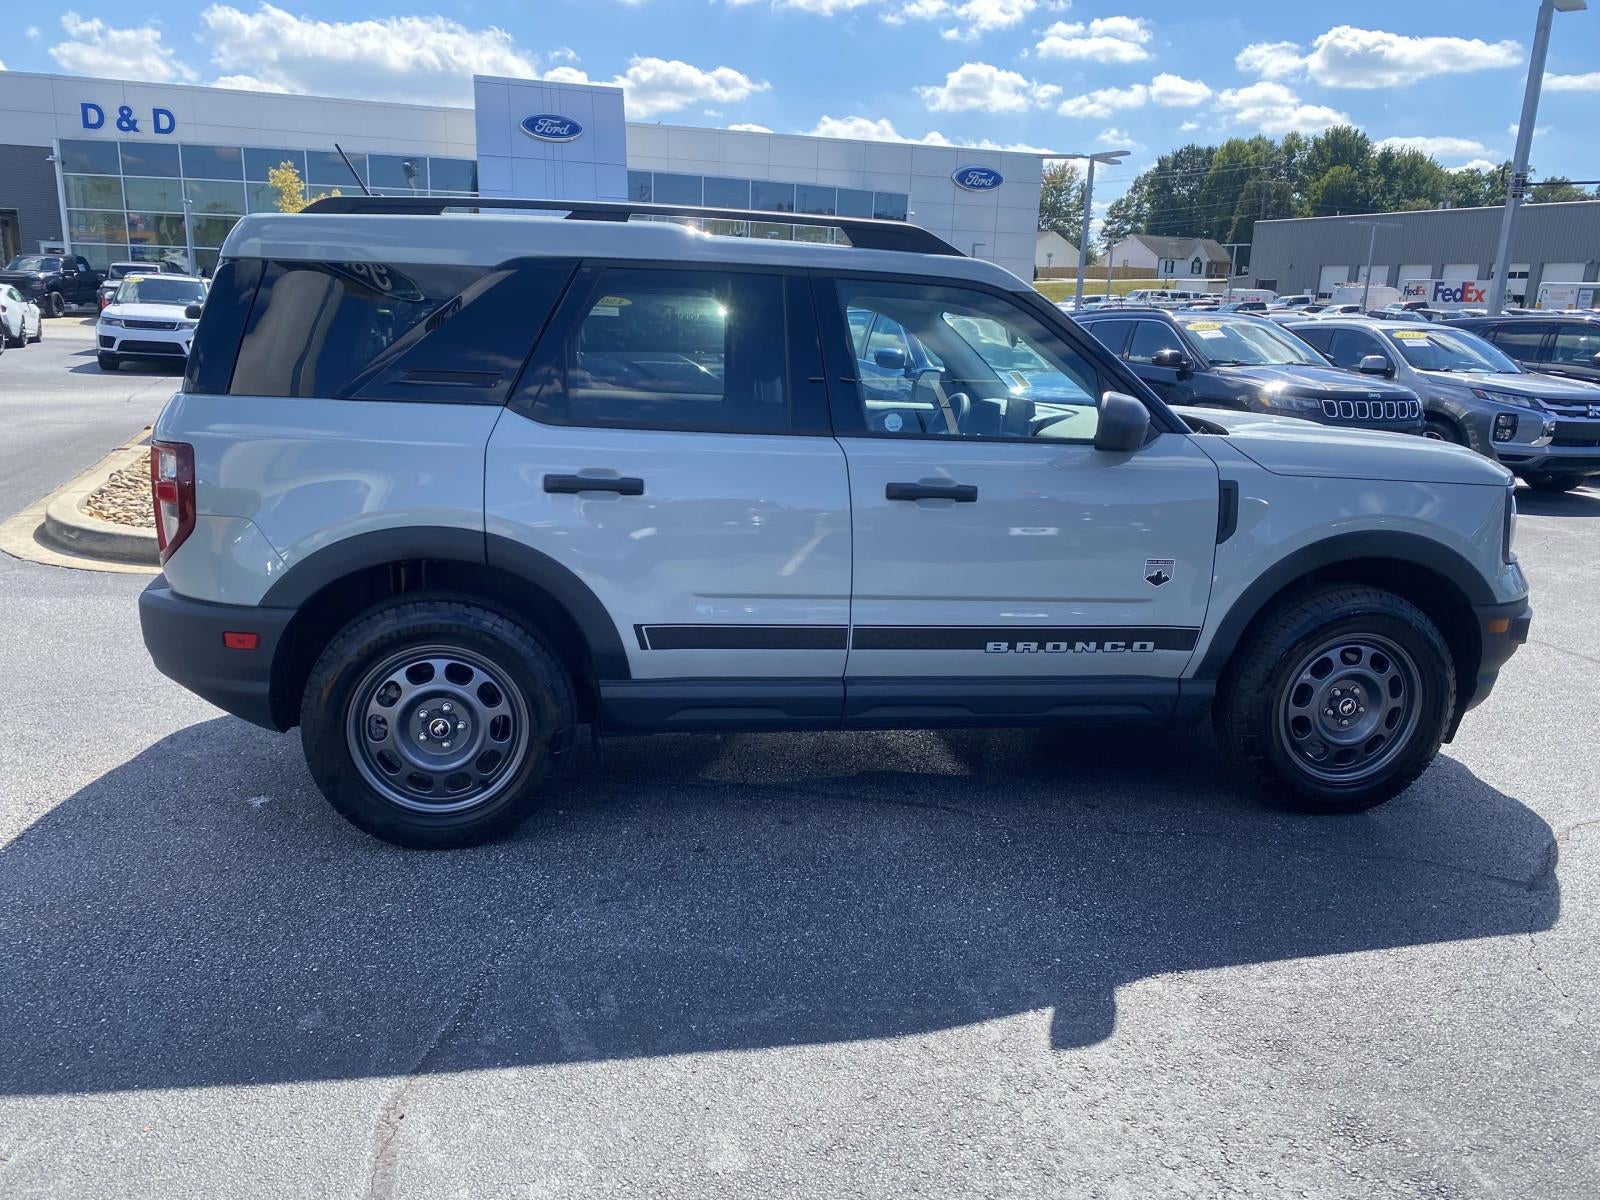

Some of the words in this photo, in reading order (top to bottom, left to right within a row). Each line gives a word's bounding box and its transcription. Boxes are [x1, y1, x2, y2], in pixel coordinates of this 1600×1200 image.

[80, 102, 105, 129] D
[116, 105, 140, 132] &
[152, 107, 176, 134] D
[534, 118, 570, 135] Ford
[965, 171, 995, 186] Ford
[1432, 281, 1487, 303] FedEx
[984, 641, 1155, 653] BRONCO
